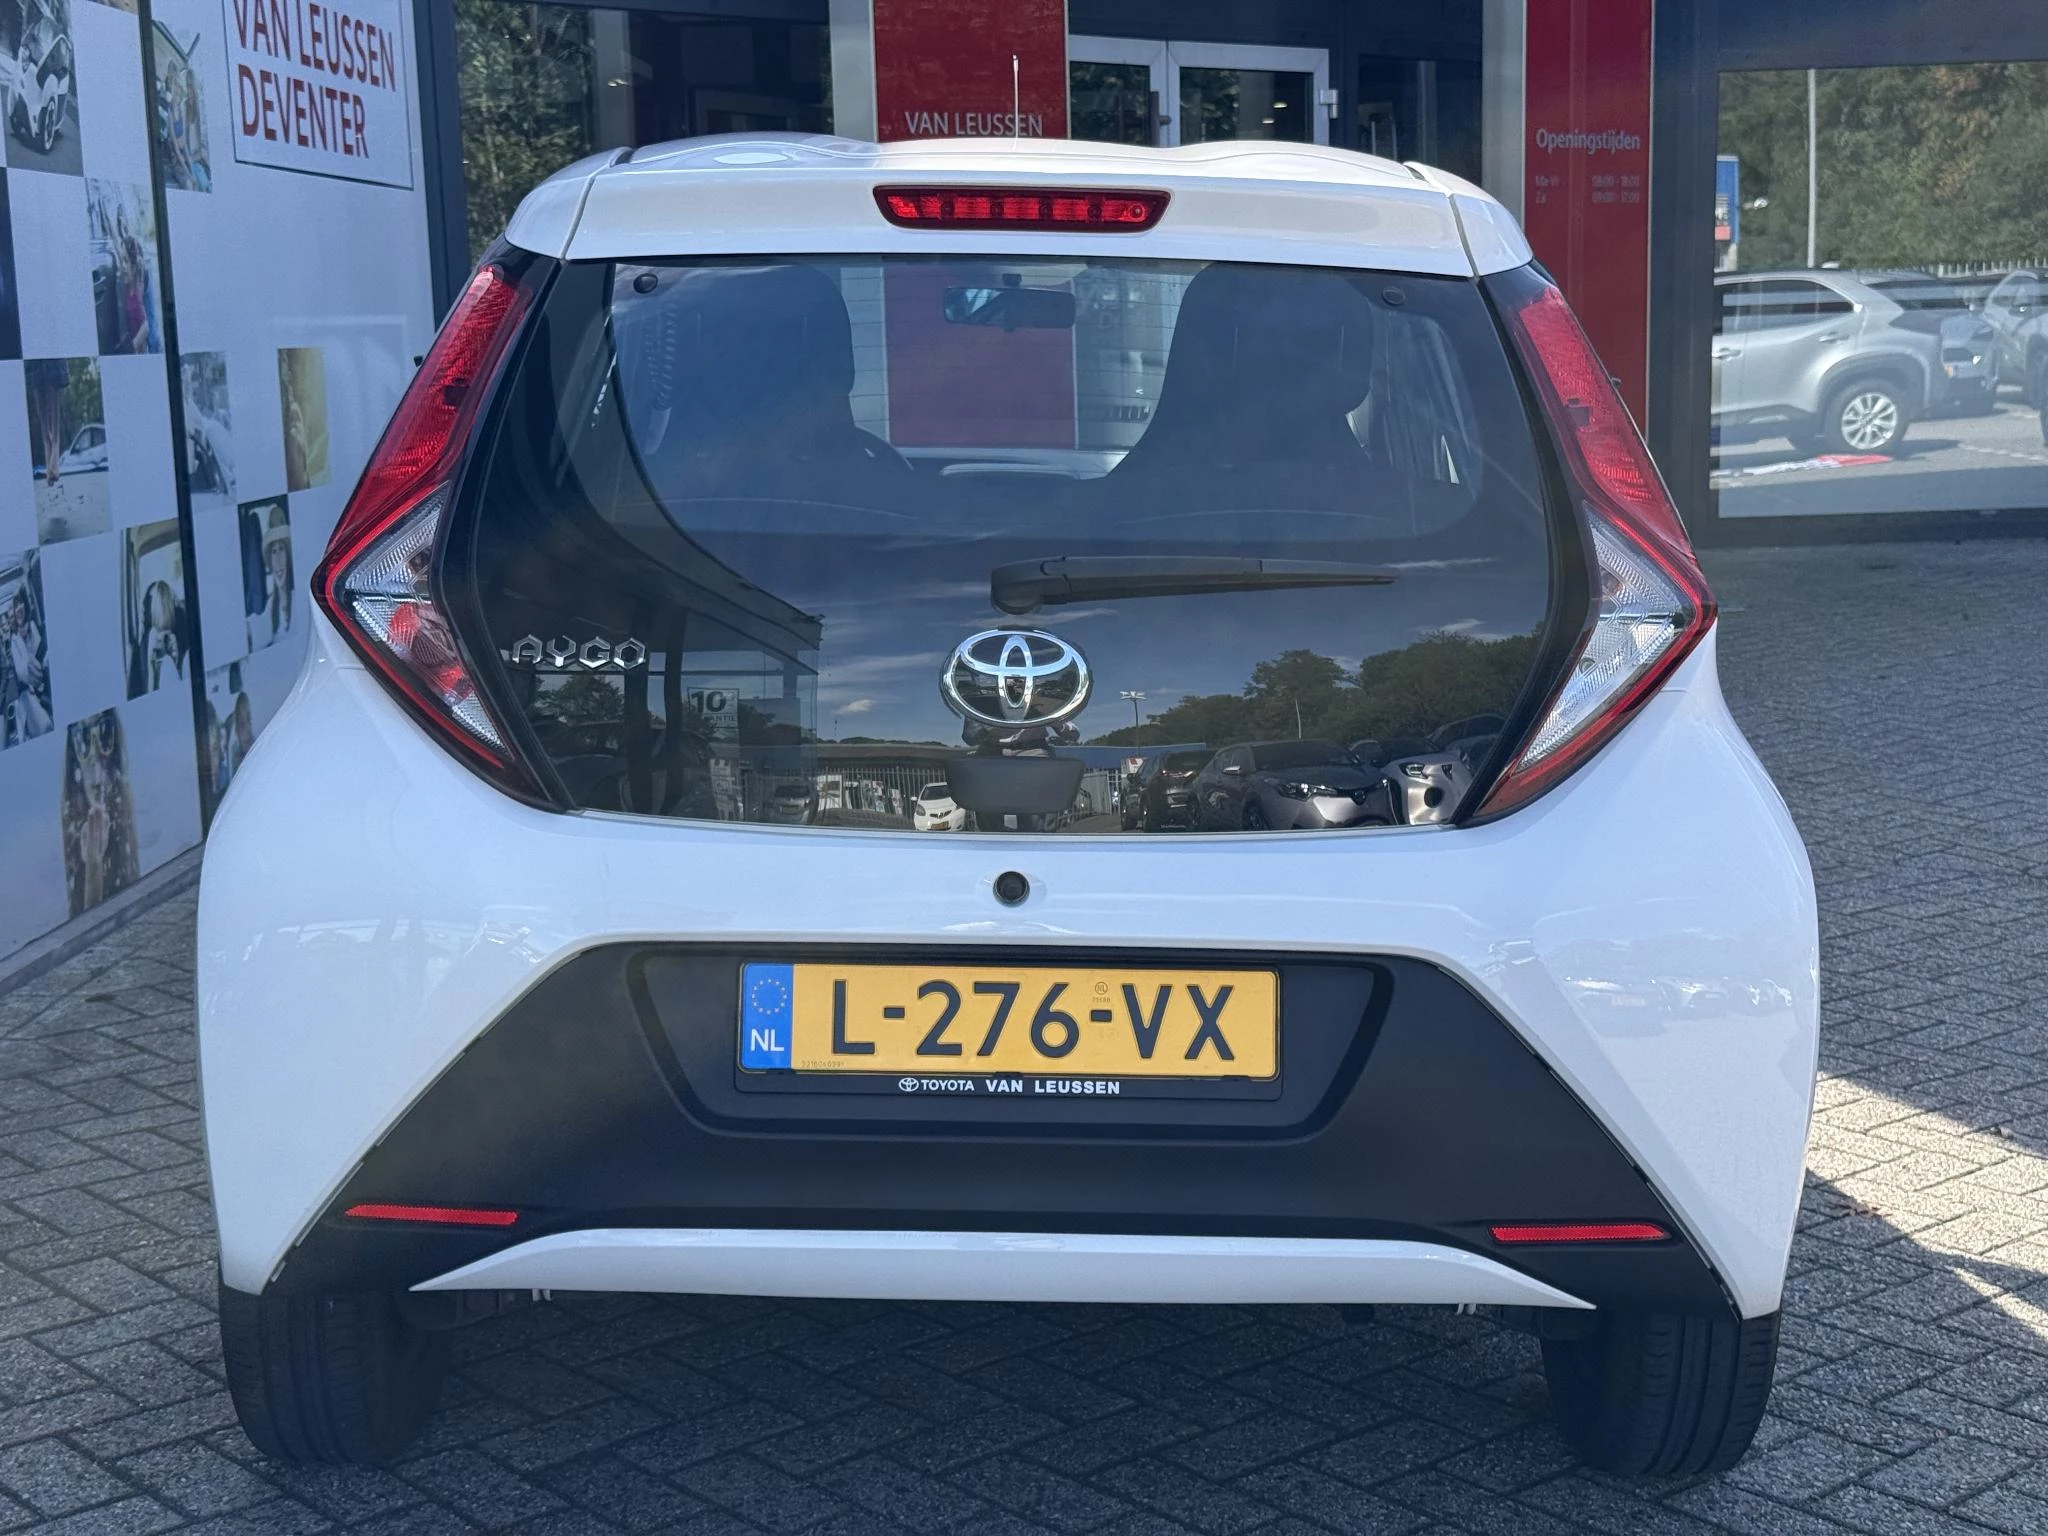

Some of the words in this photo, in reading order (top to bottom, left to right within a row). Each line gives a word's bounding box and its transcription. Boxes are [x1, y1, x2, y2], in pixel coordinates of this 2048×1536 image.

[233, 0, 291, 61] VAN
[296, 0, 396, 92] LEUSSEN
[238, 63, 370, 158] DEVENTER
[904, 111, 949, 135] VAN
[954, 112, 1043, 137] LEUSSEN
[1535, 128, 1641, 155] Openingstijden
[512, 634, 646, 670] AYGO
[691, 690, 727, 713] 10
[832, 978, 1236, 1062] L-276-VX
[749, 1028, 785, 1052] NL
[921, 1079, 975, 1092] TOYOTA
[985, 1080, 1024, 1093] VAN
[1034, 1080, 1121, 1095] LEUSSEN
